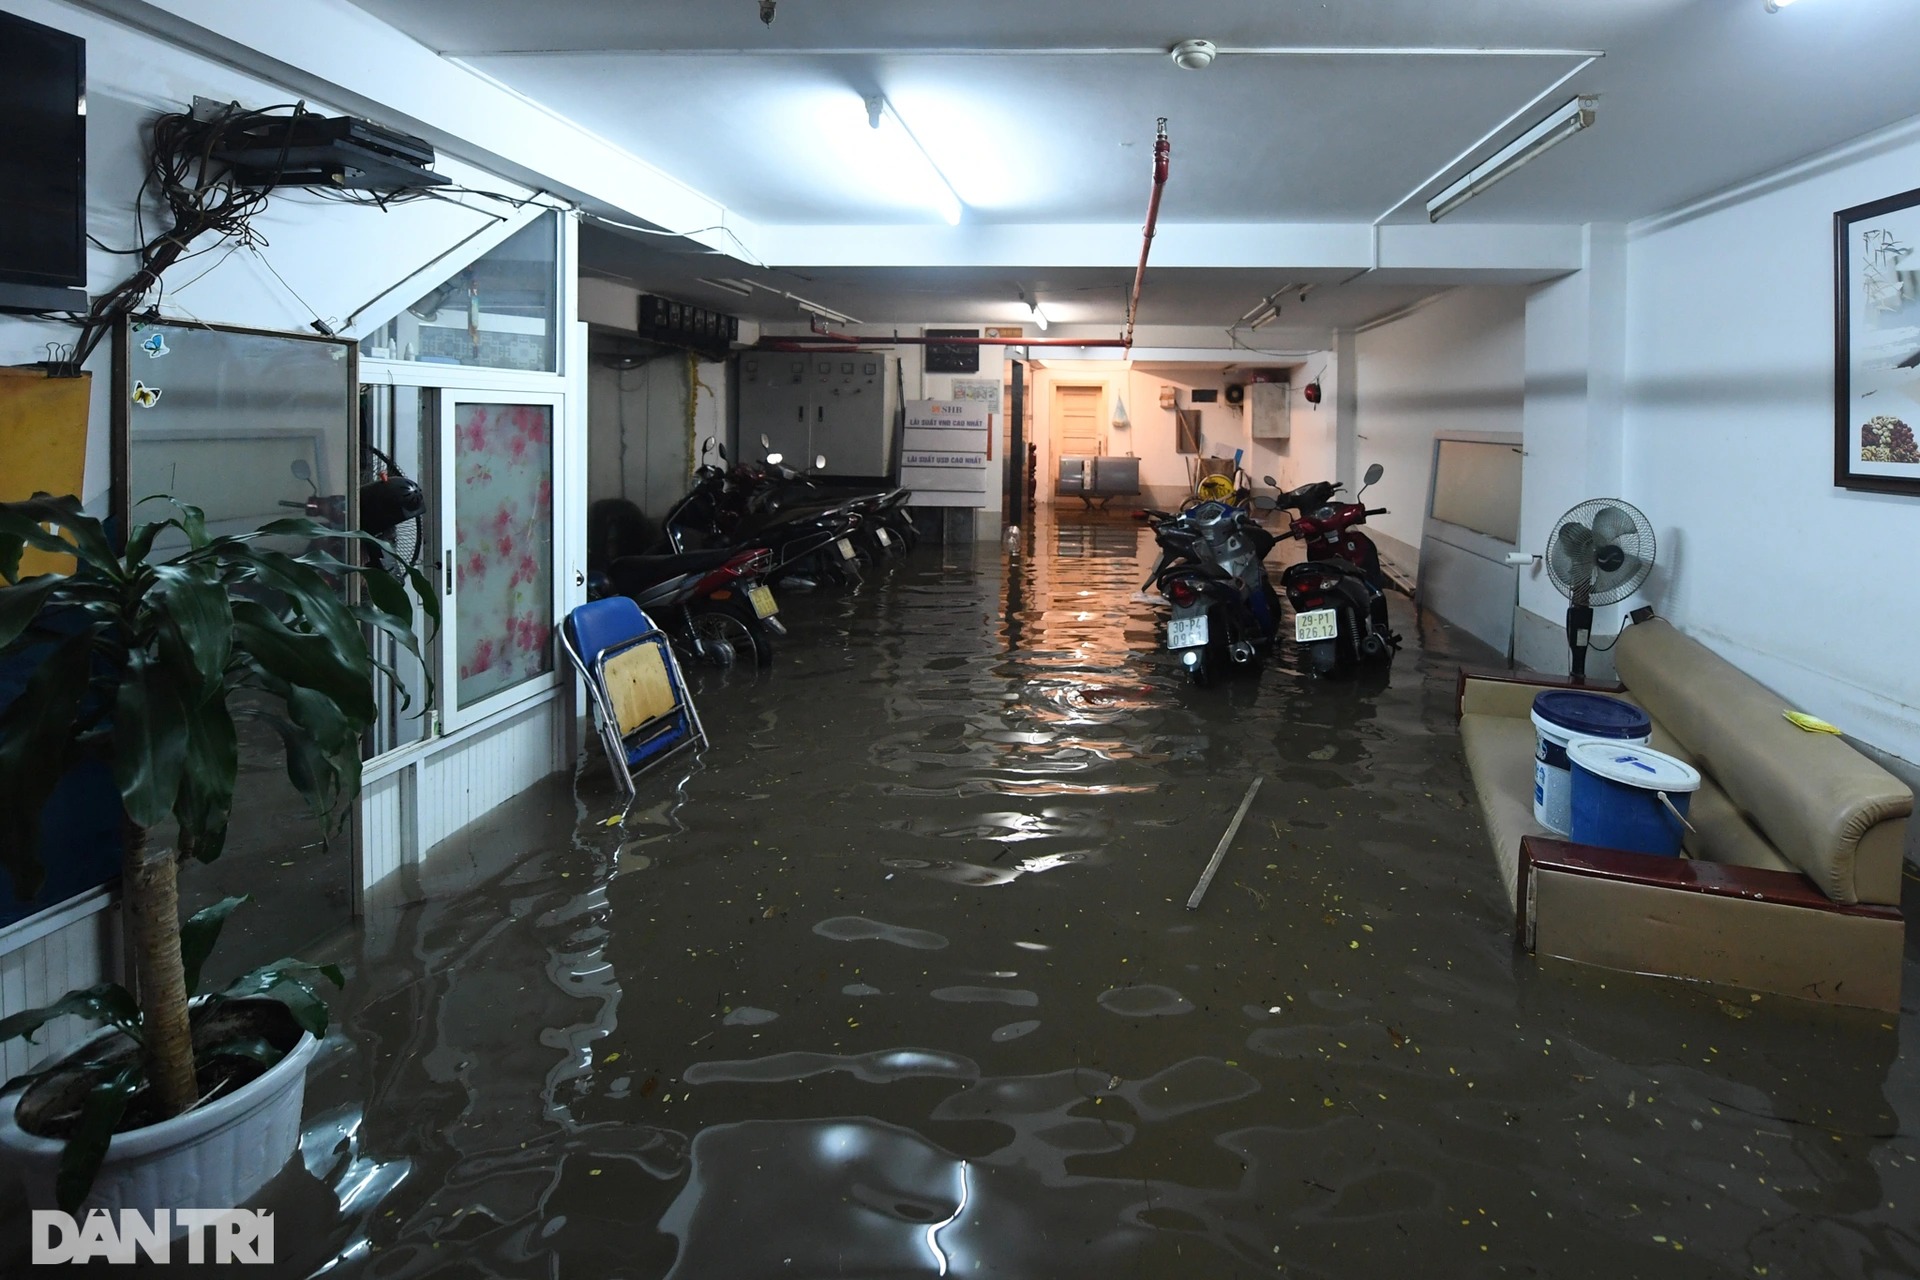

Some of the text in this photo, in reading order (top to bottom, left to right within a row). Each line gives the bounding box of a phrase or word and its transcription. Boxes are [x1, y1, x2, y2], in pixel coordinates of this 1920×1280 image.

[1173, 618, 1201, 634] 30-P4
[1302, 613, 1329, 627] 29-P1
[1299, 624, 1334, 640] 826.12
